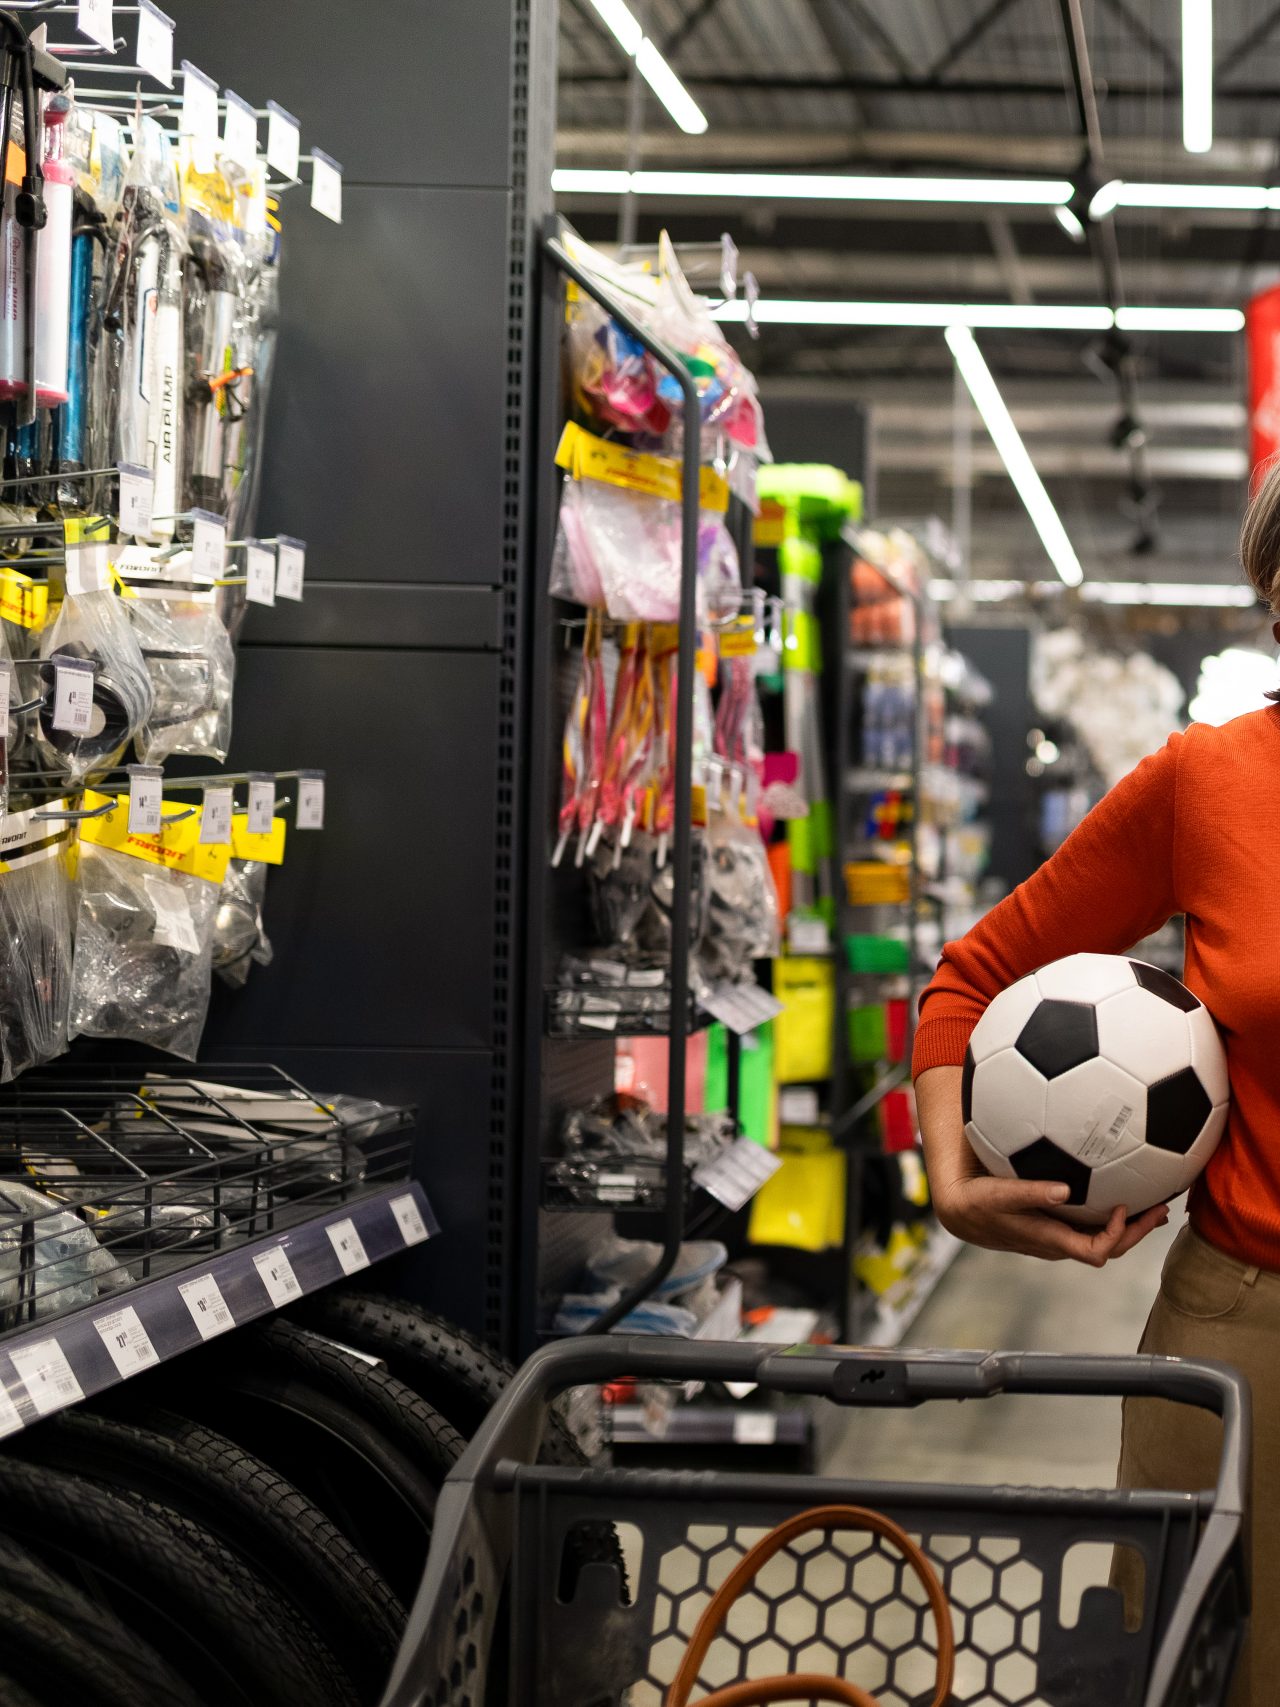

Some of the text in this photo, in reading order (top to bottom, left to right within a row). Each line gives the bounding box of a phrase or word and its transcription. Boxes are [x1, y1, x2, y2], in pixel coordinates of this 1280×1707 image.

[163, 365, 173, 464] AIR PUMP
[1, 831, 28, 845] AVORIT
